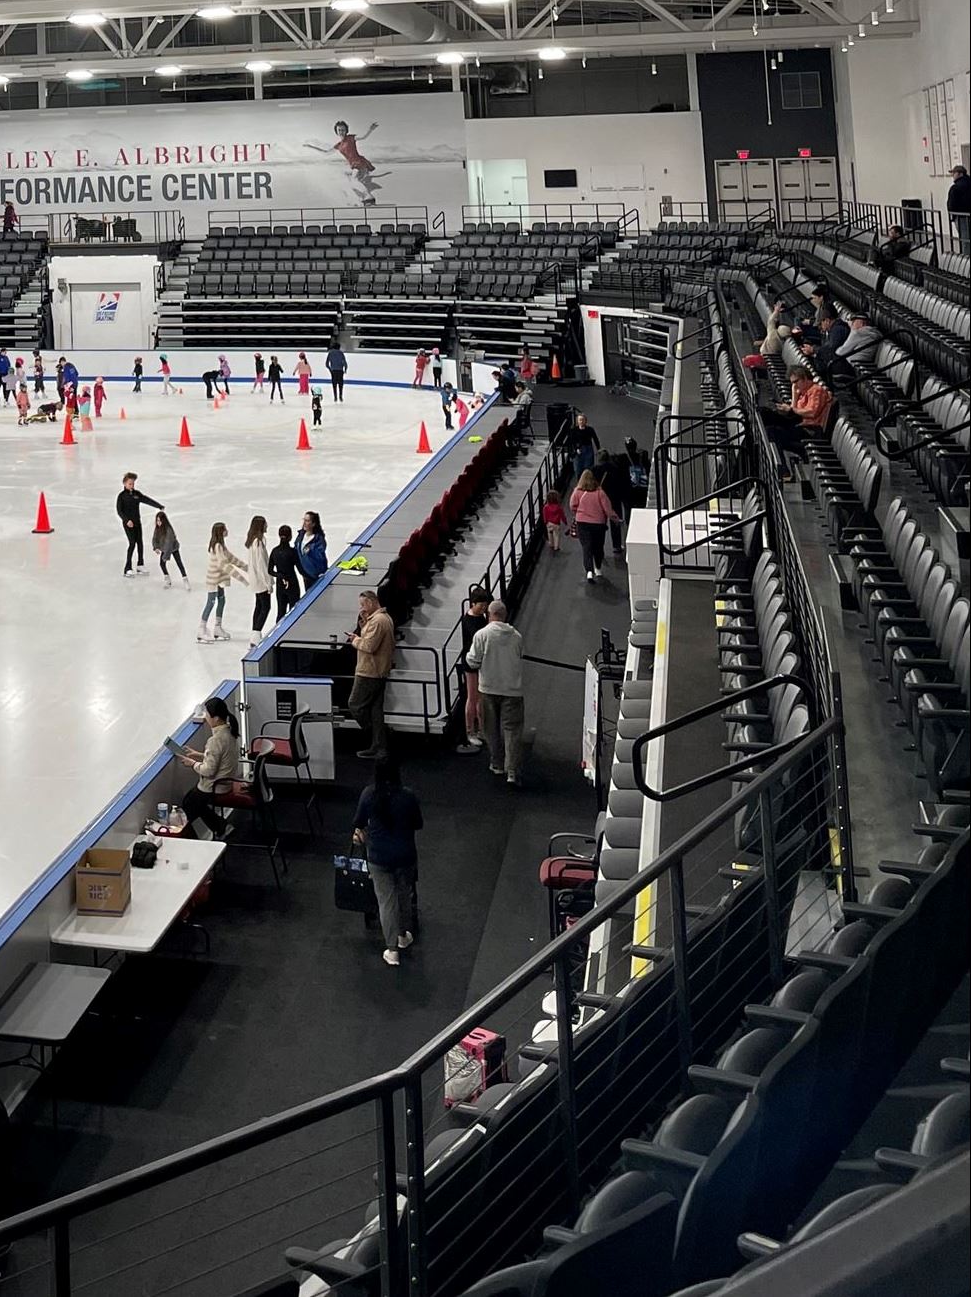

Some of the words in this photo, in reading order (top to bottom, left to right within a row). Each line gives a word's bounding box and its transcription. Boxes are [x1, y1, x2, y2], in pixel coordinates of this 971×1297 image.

[76, 149, 99, 168] E.
[114, 143, 272, 166] ALBRIGHT
[161, 171, 273, 202] CENTER
